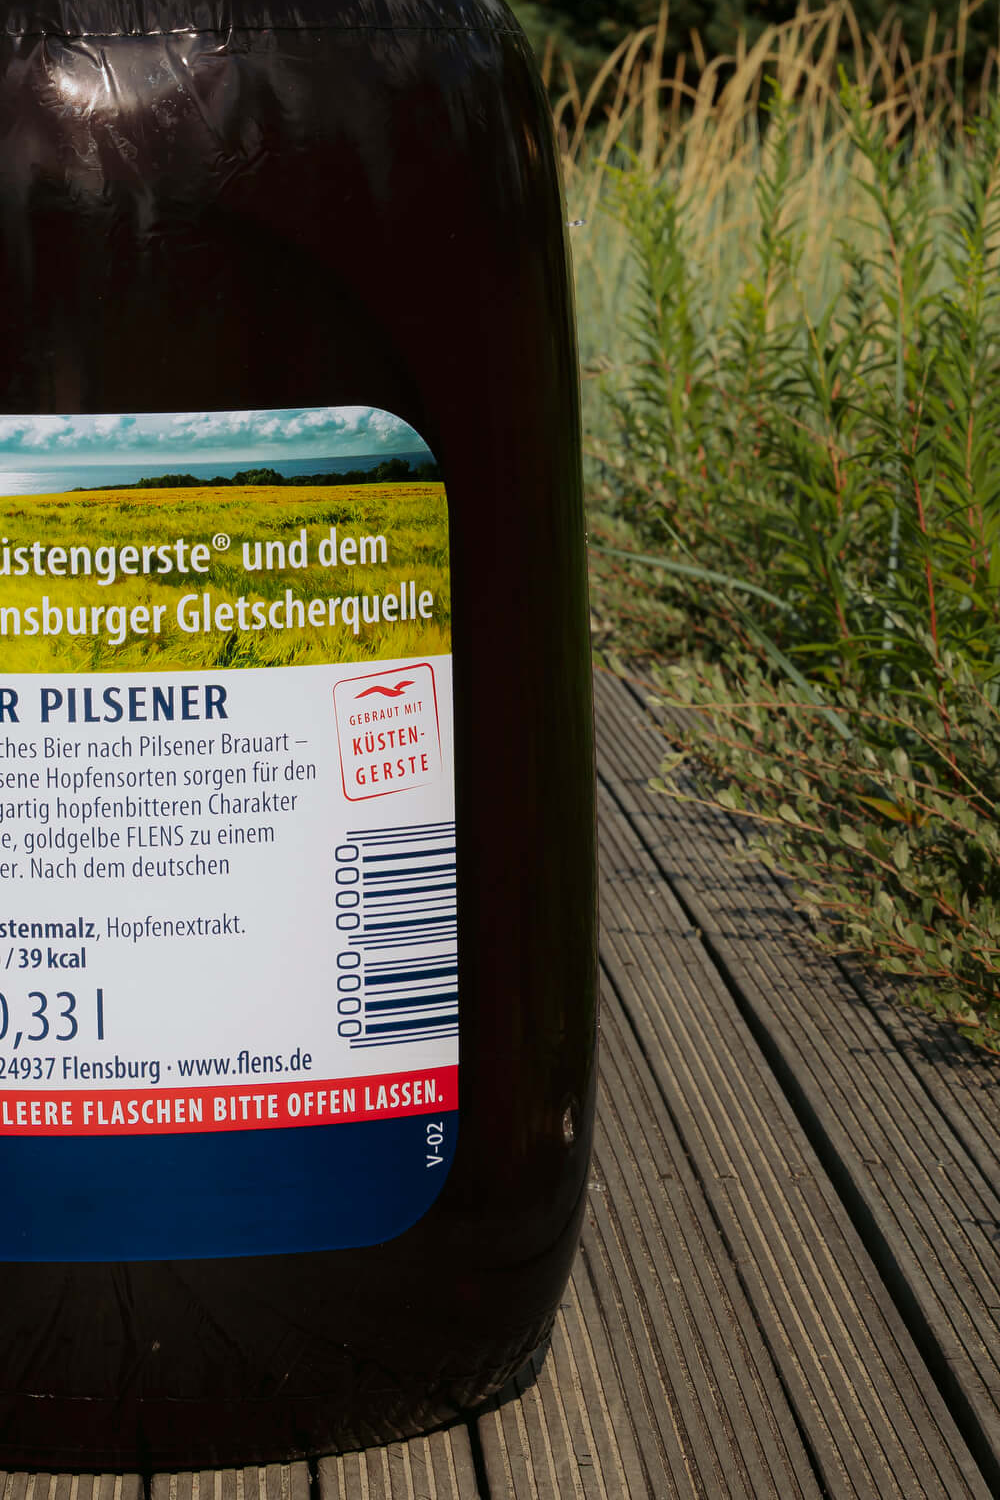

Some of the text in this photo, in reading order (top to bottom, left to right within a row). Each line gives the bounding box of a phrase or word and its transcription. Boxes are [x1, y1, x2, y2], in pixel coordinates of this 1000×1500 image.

[243, 529, 307, 570] und
[319, 527, 387, 566] dem
[177, 581, 433, 634] Gletscherquelle
[41, 685, 228, 722] PILSENER
[350, 701, 422, 725] GEBRAUT MIT
[45, 738, 80, 758] Bier
[88, 736, 131, 757] nach
[140, 735, 215, 756] Pilsener
[222, 734, 288, 754] Brauart
[353, 726, 426, 756] KÜSTEN-
[47, 767, 176, 793] Hopfensorten
[184, 768, 245, 790] sorgen
[253, 761, 278, 782] für
[285, 760, 315, 780] den
[356, 754, 428, 784] GERSTE
[57, 796, 201, 823] hopfenbitteren
[209, 791, 297, 814] Charakter
[25, 827, 119, 854] goldgelbe
[128, 826, 183, 847] FLENS
[191, 830, 210, 845] zu
[218, 824, 273, 844] einem
[31, 857, 76, 878] Nach
[84, 857, 124, 877] dem
[133, 855, 229, 877] deutschen
[108, 913, 245, 943] Hopfenextrakt.
[19, 949, 42, 968] 39
[48, 947, 85, 968] kcal
[63, 1056, 160, 1084] Flensburg
[178, 1048, 312, 1076] www.flens.de
[3, 1102, 72, 1125] LEERE
[84, 1098, 202, 1124] FLASCHEN
[214, 1095, 278, 1121] BITTE
[288, 1089, 355, 1116] OFFEN
[365, 1079, 442, 1110] LASSEN.
[427, 1122, 443, 1167] V-02
